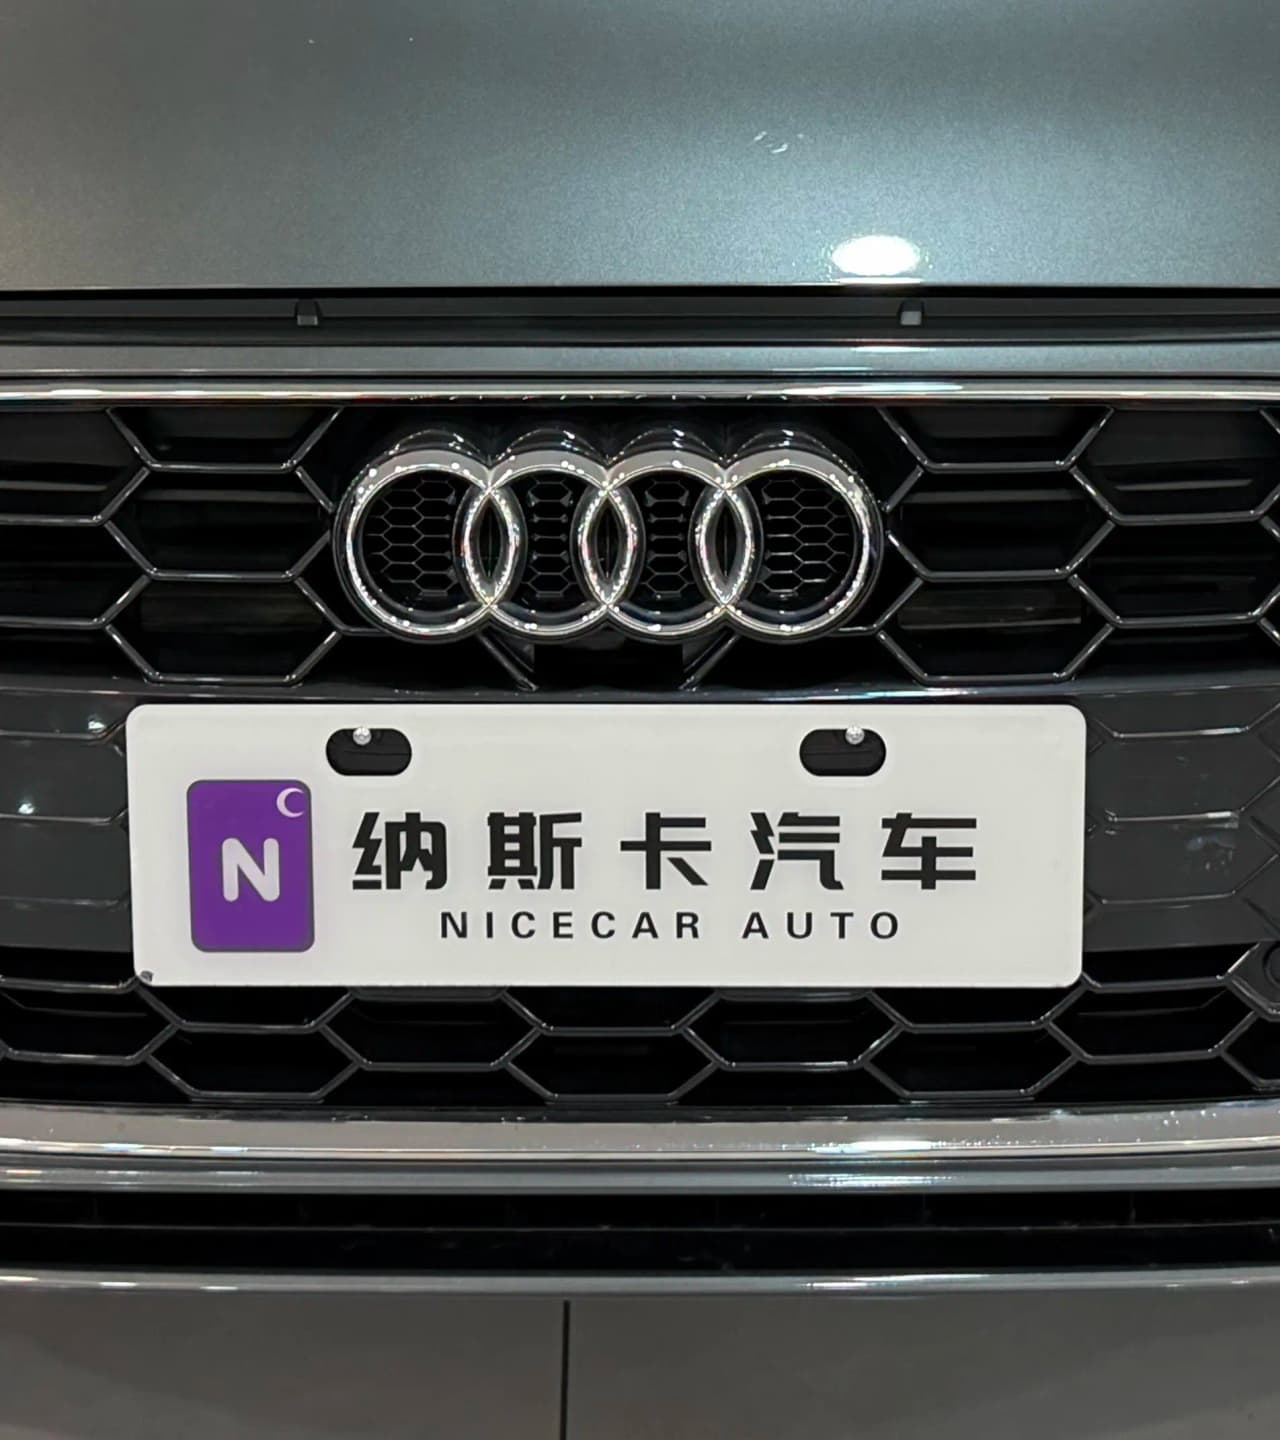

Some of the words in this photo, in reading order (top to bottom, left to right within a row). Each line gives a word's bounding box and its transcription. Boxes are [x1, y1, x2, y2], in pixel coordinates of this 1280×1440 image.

[221, 838, 280, 902] N
[352, 811, 977, 891] 纳斯卡汽车
[441, 911, 699, 939] NICECAR
[742, 911, 898, 939] AUTO
